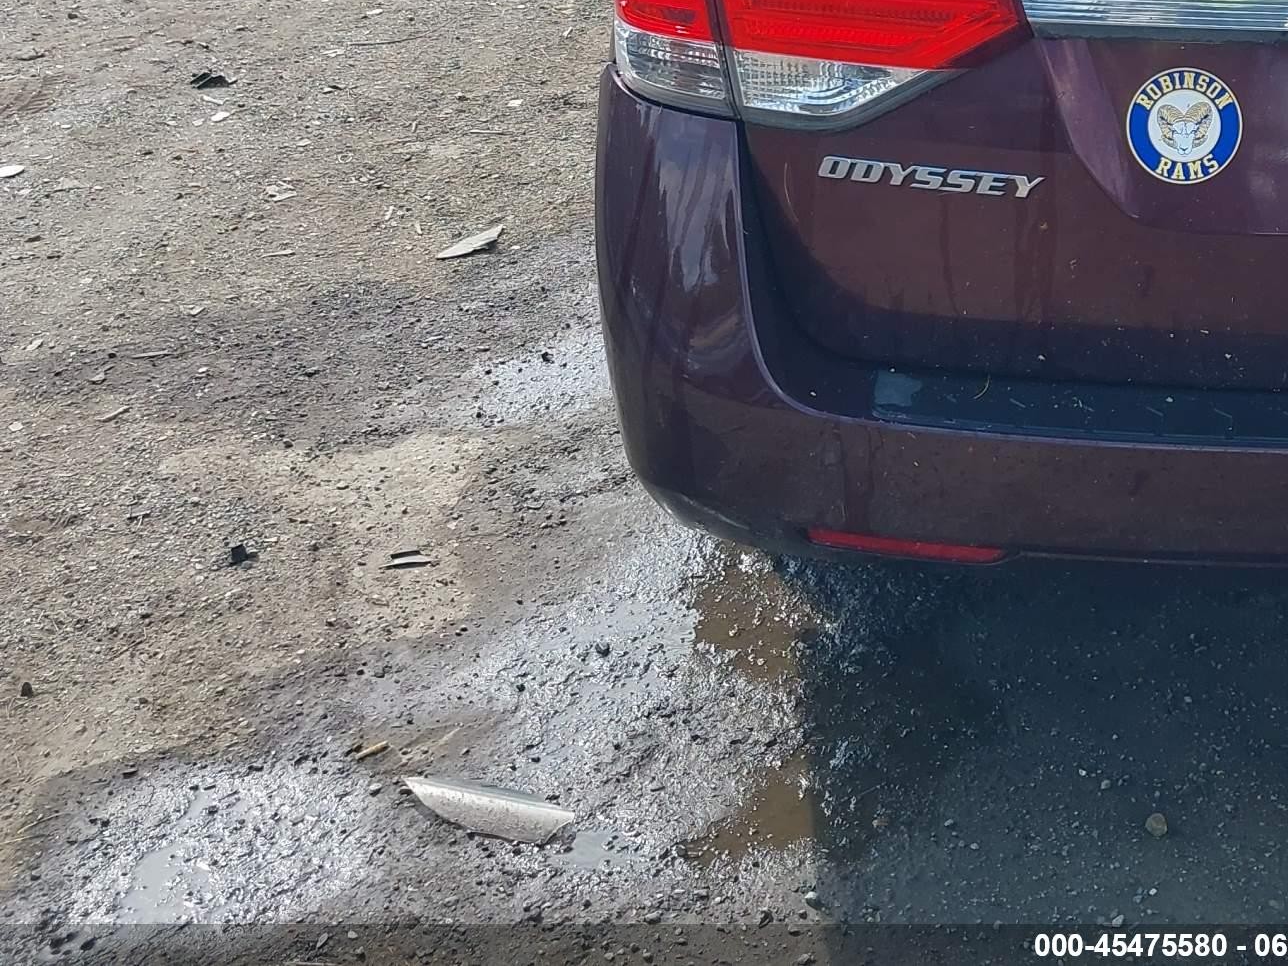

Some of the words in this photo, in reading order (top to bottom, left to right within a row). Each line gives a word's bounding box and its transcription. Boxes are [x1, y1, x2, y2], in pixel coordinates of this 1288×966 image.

[1135, 71, 1234, 111] ROBINSON
[818, 155, 1048, 199] ODYSSEY
[1155, 154, 1220, 180] RAMS
